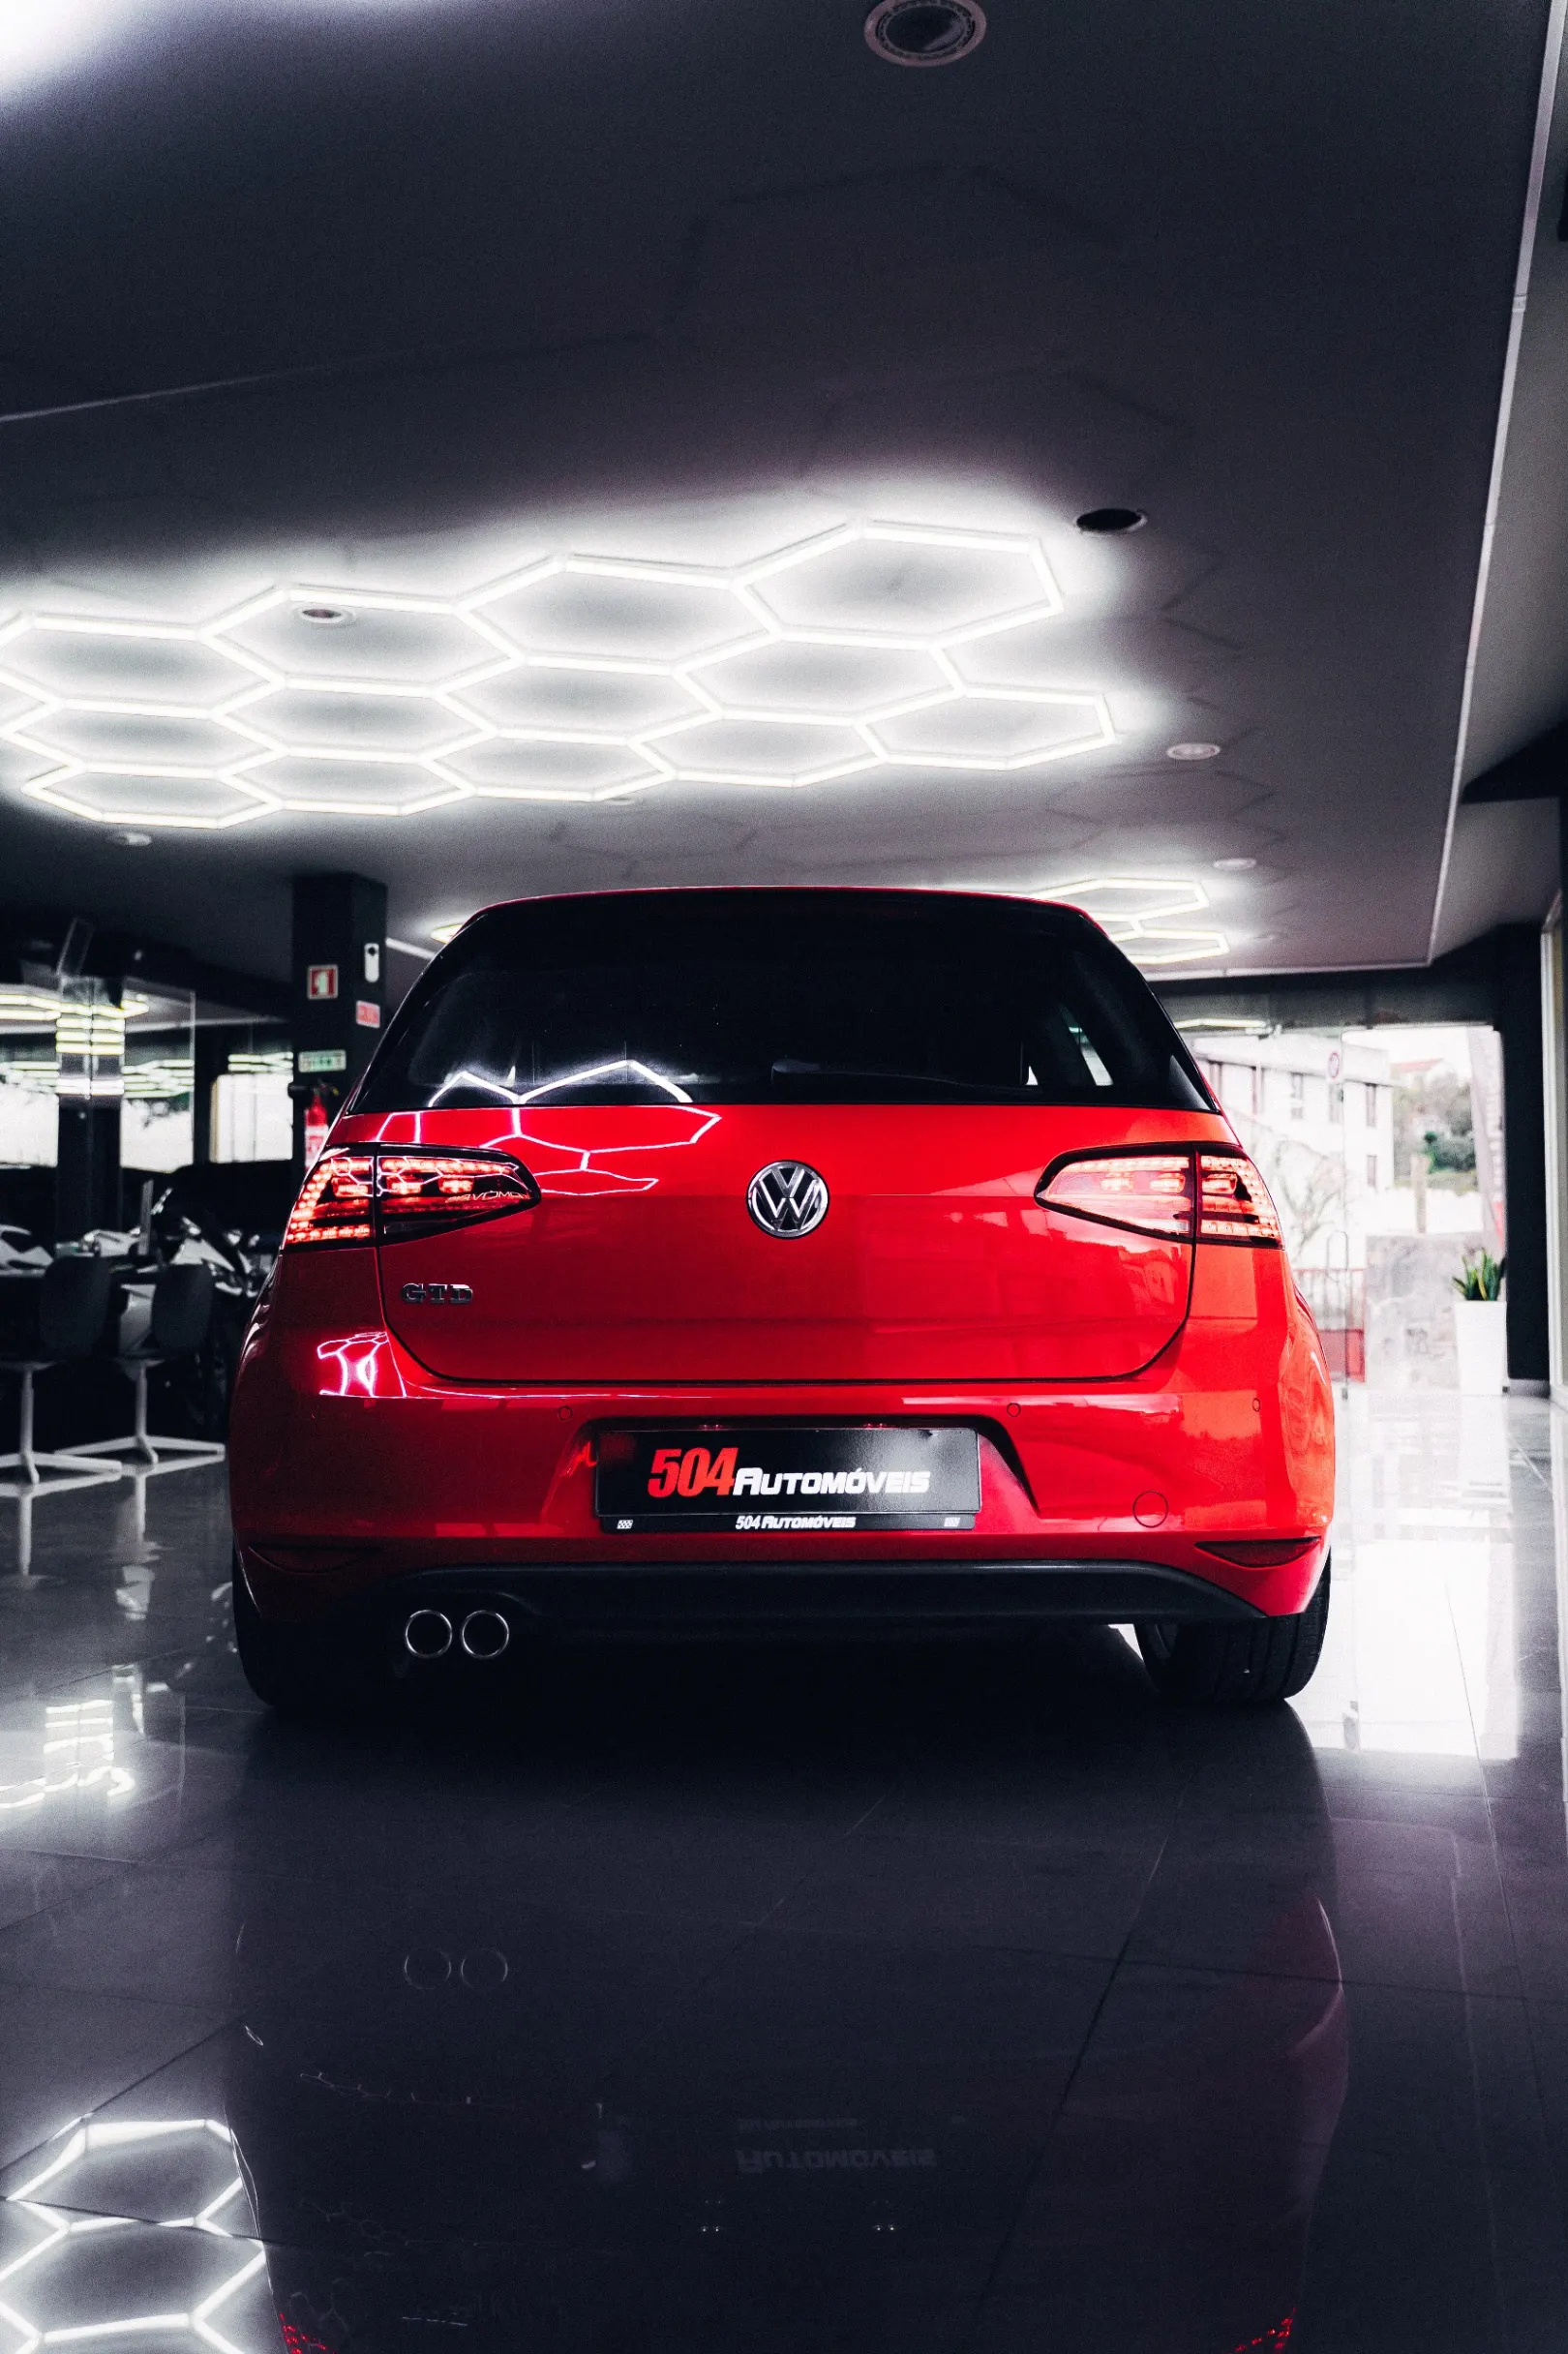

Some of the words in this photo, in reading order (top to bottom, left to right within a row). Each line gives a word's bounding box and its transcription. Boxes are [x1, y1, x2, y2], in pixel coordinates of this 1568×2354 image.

[749, 1162, 825, 1236] VW
[401, 1283, 472, 1304] GTD
[648, 1447, 738, 1497] 504
[736, 1515, 761, 1529] 504
